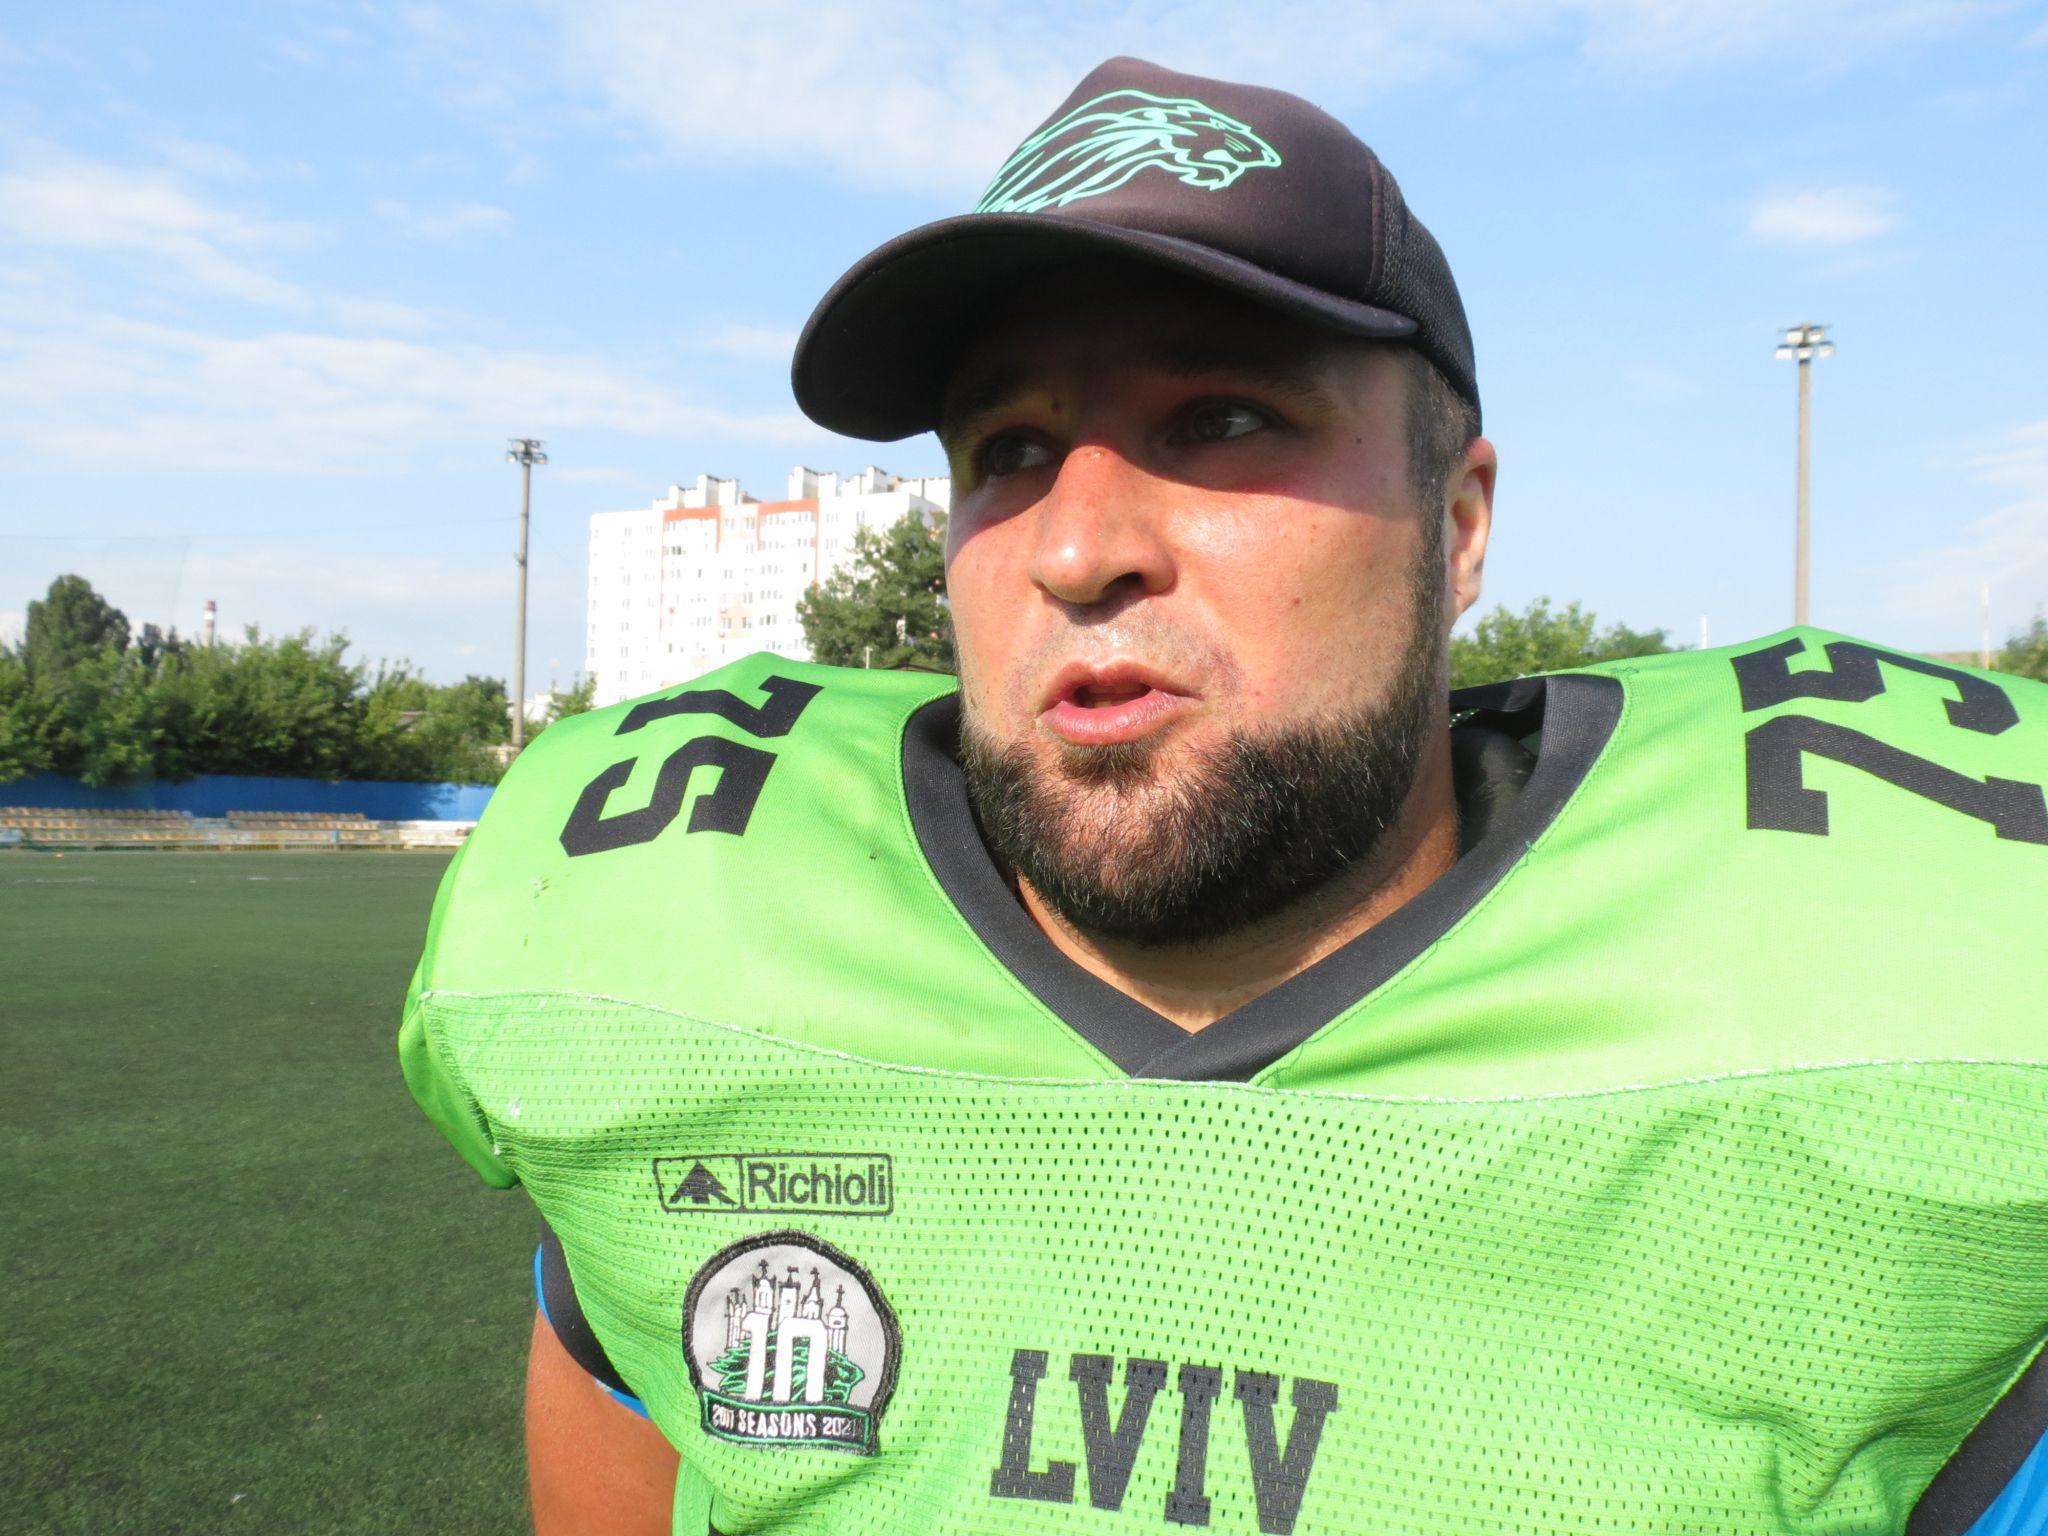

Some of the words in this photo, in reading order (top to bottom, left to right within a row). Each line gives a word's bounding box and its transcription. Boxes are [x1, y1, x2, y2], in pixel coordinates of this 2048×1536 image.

[559, 675, 825, 857] 75
[1729, 637, 2048, 846] 75
[748, 1162, 886, 1205] Richioli
[738, 1409, 817, 1438] SEASONS
[990, 1348, 1339, 1535] LVIV
